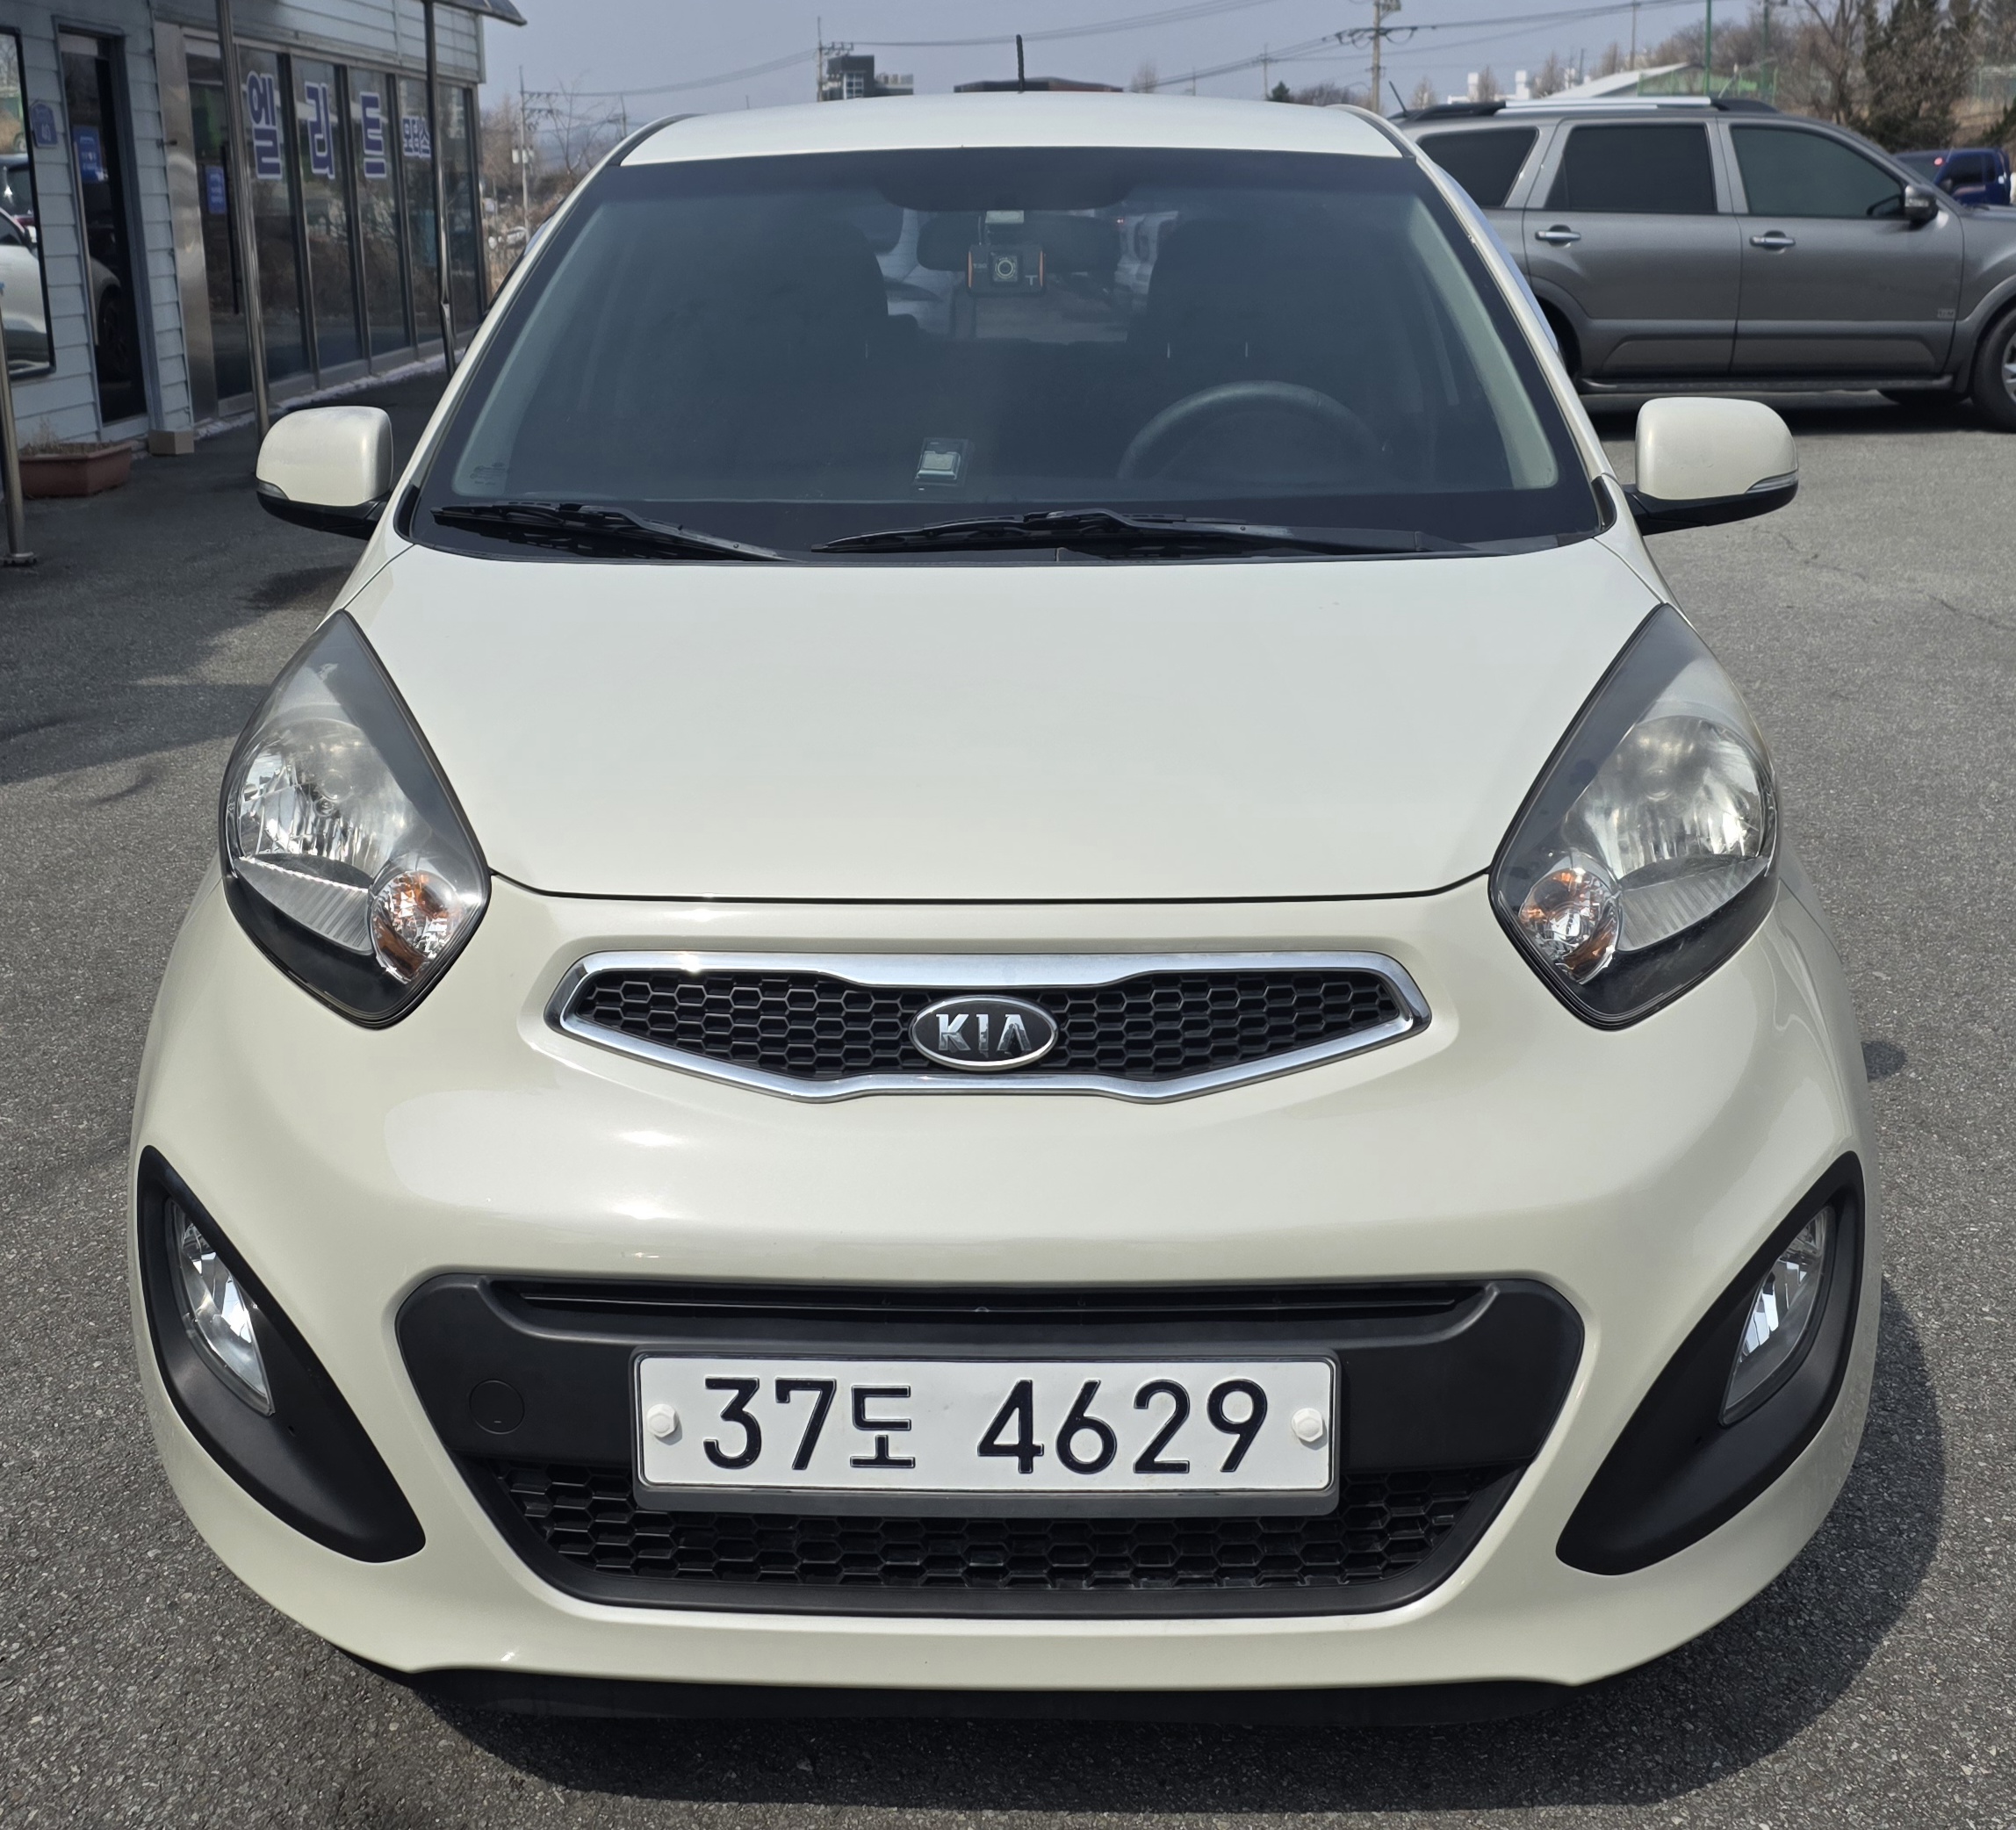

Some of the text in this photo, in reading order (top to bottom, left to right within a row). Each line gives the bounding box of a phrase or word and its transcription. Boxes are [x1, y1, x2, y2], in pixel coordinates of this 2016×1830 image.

[247, 70, 386, 179] 엘리트
[935, 1013, 1032, 1052] KIA
[702, 1376, 1269, 1474] 37도 4629
